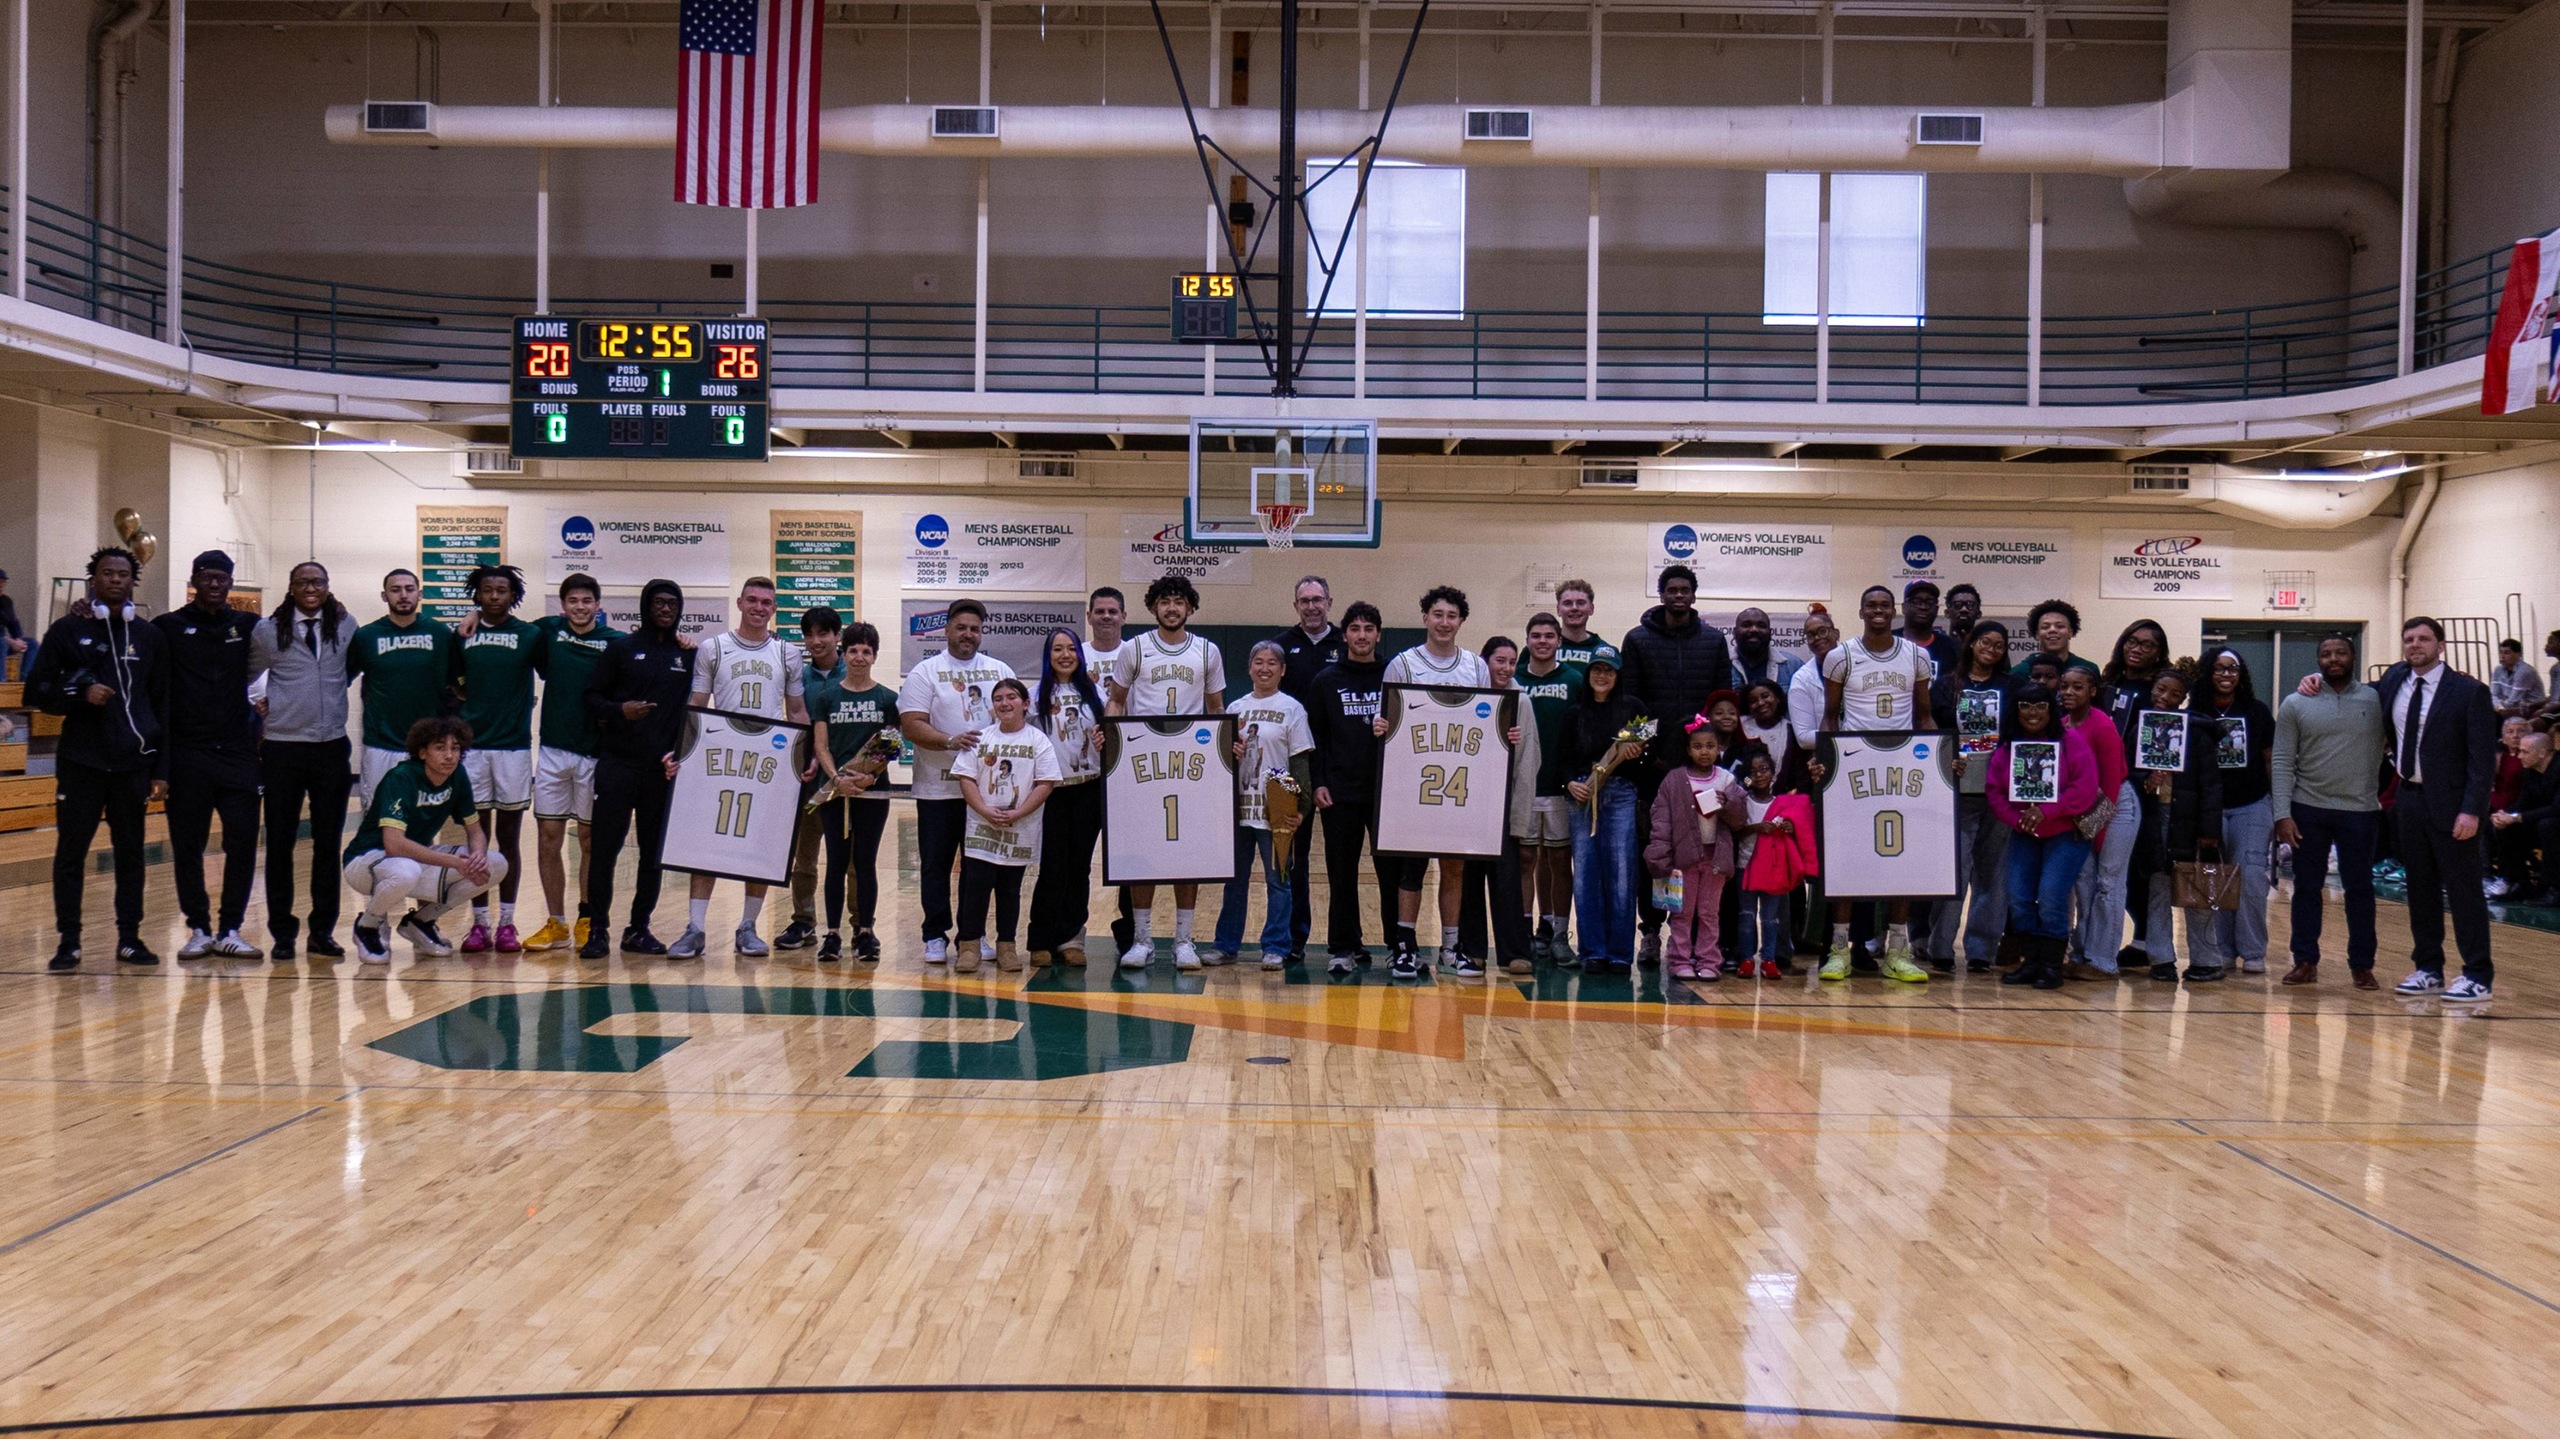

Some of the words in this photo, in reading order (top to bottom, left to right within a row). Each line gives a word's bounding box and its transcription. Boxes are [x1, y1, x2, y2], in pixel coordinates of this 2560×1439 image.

[524, 322, 568, 338] HOME
[706, 324, 766, 340] VISITOR
[600, 325, 692, 357] 12:55
[528, 344, 571, 377] 20
[718, 346, 759, 379] 26
[617, 366, 640, 374] POSS
[608, 375, 648, 387] PERIOD
[662, 369, 671, 397] 1
[541, 383, 578, 395] BONUS
[701, 385, 738, 397] BONUS
[533, 403, 568, 414] FOULS
[602, 403, 643, 415] PLAYER
[652, 404, 686, 416] FOULS
[711, 405, 746, 416] FOULS
[549, 416, 567, 443] 0
[727, 417, 744, 444] 0
[599, 522, 650, 531] WOMEN'S
[654, 523, 725, 532] BASKETBALL
[965, 524, 998, 533] MEN'S
[1002, 525, 1074, 534] BASKETBALL
[565, 532, 595, 541] NCAA
[620, 535, 703, 544] CHAMPIONSHIP
[920, 531, 949, 540] NCAA
[977, 537, 1060, 547] CHAMPIONSHIP
[1700, 533, 1751, 543] WOMEN'S
[1755, 534, 1825, 544] VOLLEYBALL
[1131, 543, 1164, 553] MEN'S
[1168, 544, 1240, 554] BASKETBALL
[1667, 541, 1697, 550] NCAA
[1720, 546, 1804, 556] CHAMPIONSHIP
[1951, 542, 1984, 551] MEN'S
[1987, 542, 2058, 552] VOLLEYBALL
[2144, 539, 2192, 555] ECAC
[1153, 556, 1219, 566] CHAMPIONS
[1906, 552, 1936, 561] NCAA
[1962, 554, 2045, 564] CHAMPIONSHIP
[2114, 557, 2147, 566] MEN'S
[2151, 558, 2221, 567] VOLLEYBALL
[1165, 567, 1206, 577] 2009-10
[2134, 570, 2200, 580] CHAMPIONS
[2153, 583, 2180, 592] 2009
[2278, 591, 2297, 605] EXIT
[917, 615, 948, 630] NEC
[1005, 614, 1076, 623] BASKETBALL
[378, 634, 433, 655] BLAZERS
[731, 660, 773, 680] ELMS
[938, 670, 1000, 683] BLAZERS
[1151, 664, 1194, 685] ELMS
[1862, 671, 1907, 692] ELMS
[740, 682, 761, 709] 11
[1166, 687, 1177, 714] 1
[840, 700, 876, 712] ELMS
[1344, 705, 1380, 715] BASKETBA
[1876, 693, 1893, 719] 0
[830, 711, 885, 724] COLLEGE
[1411, 723, 1483, 756] ELMS
[978, 744, 1034, 759] BLAZERS
[706, 748, 777, 784] ELMS
[1131, 751, 1205, 784] ELMS
[2142, 755, 2181, 767] 2026
[1419, 765, 1468, 807] 24
[1848, 766, 1925, 800] ELMS
[2016, 787, 2055, 798] 2026
[715, 789, 753, 838] 11
[1163, 794, 1179, 841] 1
[1874, 810, 1904, 857] 0
